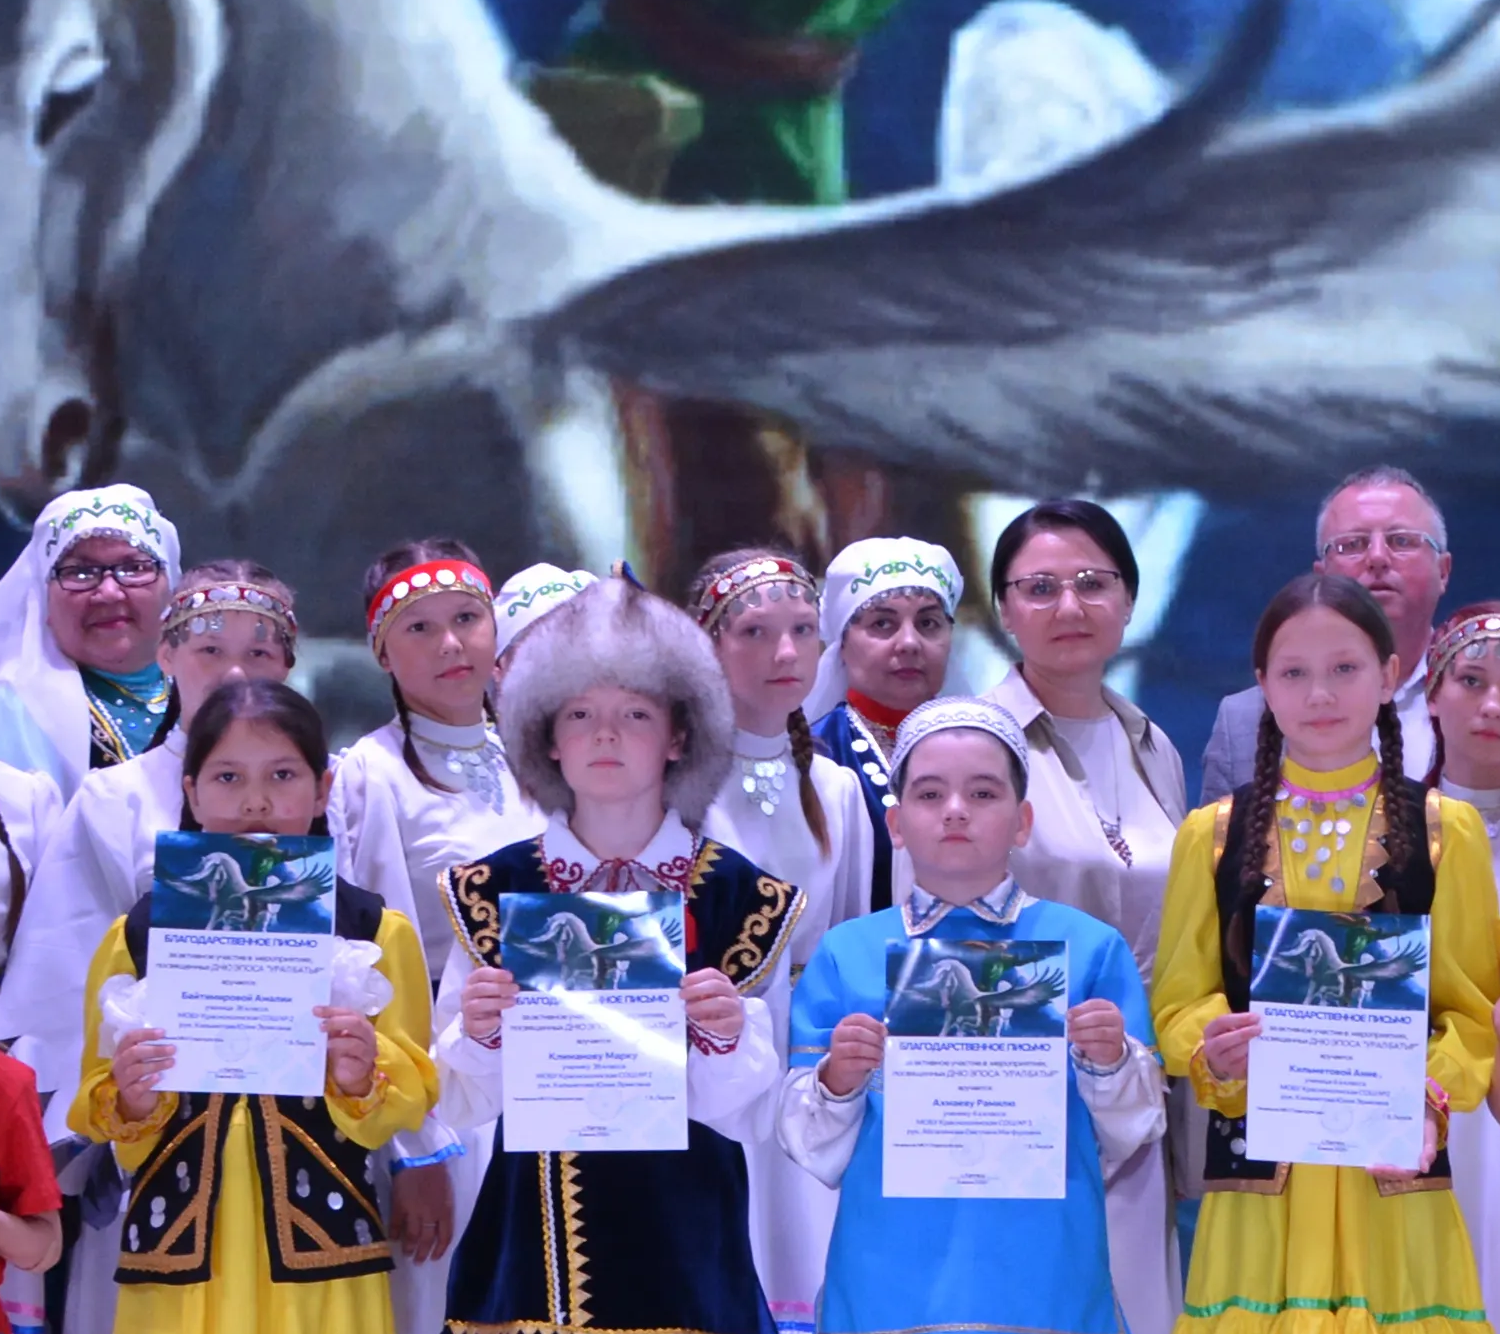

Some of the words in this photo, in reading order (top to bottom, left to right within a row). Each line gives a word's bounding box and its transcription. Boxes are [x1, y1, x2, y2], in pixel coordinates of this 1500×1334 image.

[165, 934, 270, 948] БЛАГОДАРСТВЕННОЕ
[273, 938, 317, 949] ПИСЬМО
[625, 995, 669, 1004] ПИСЬМО
[1264, 1007, 1366, 1023] БЛАГОДАРСТВЕННОЕ
[1368, 1014, 1412, 1025] ПИСЬМО
[899, 1042, 1005, 1052] БЛАГОДАРСТВЕННОЕ
[1007, 1043, 1051, 1052] ПИСЬМО
